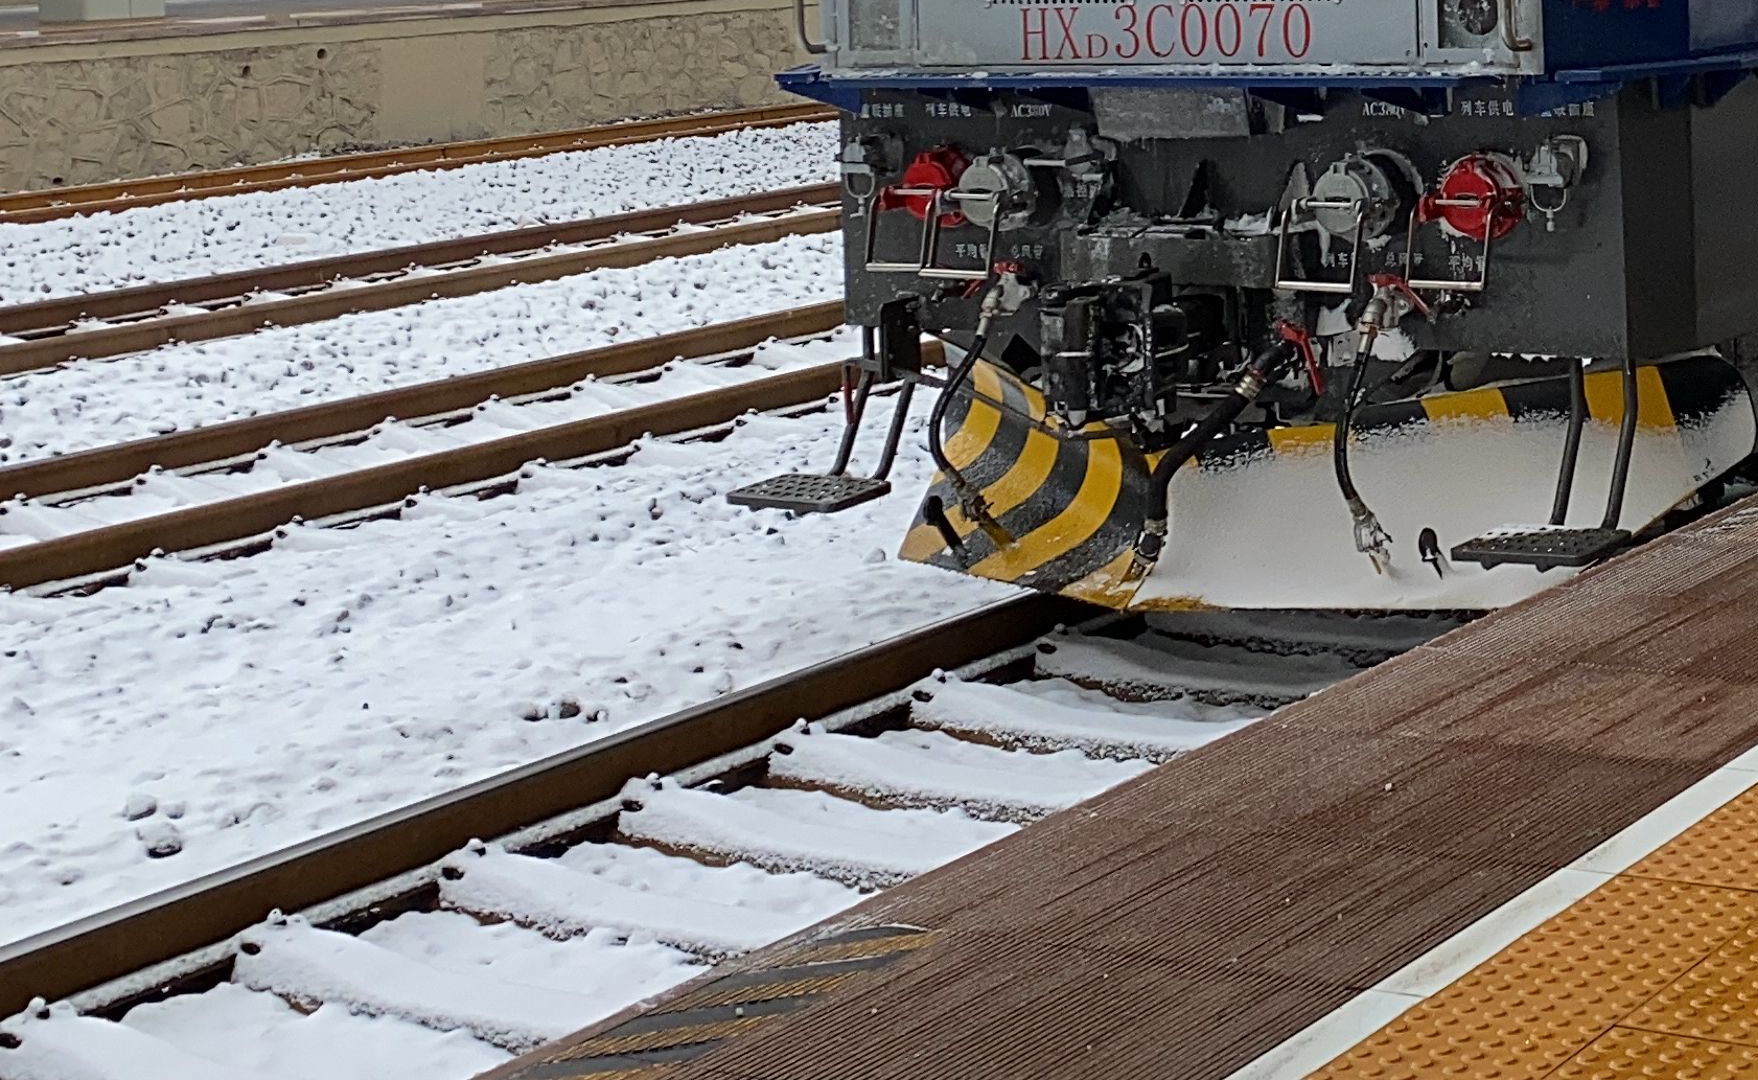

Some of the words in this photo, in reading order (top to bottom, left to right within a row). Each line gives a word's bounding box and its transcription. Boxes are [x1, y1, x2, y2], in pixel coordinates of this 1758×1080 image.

[1020, 3, 1312, 61] HXD3C0070
[1461, 99, 1514, 116] 列车供电
